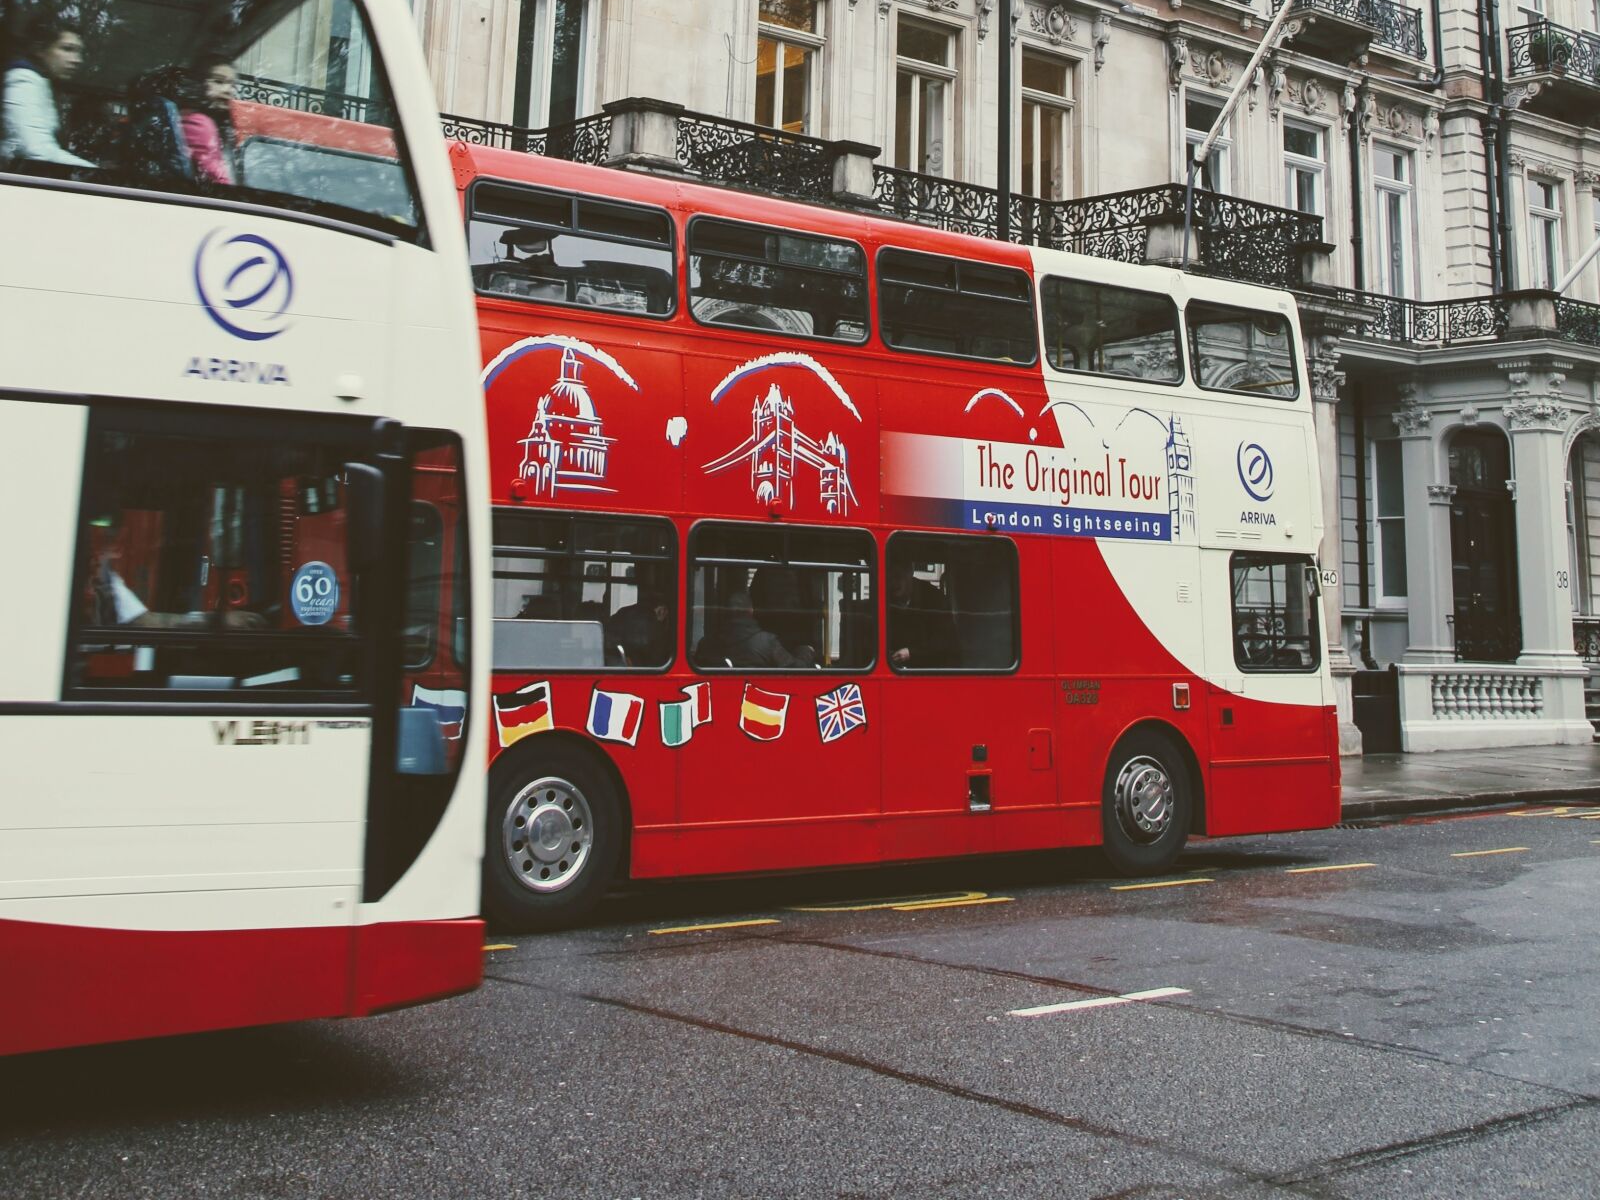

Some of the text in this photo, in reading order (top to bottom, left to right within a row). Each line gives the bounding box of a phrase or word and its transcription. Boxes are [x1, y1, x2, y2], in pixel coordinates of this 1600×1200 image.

[977, 443, 1161, 506] The Original Tour
[972, 508, 1162, 537] London Sightseeing
[1240, 511, 1276, 526] ARRIVA
[296, 575, 331, 602] 60
[1323, 571, 1337, 585] 40
[1556, 570, 1569, 589] 38
